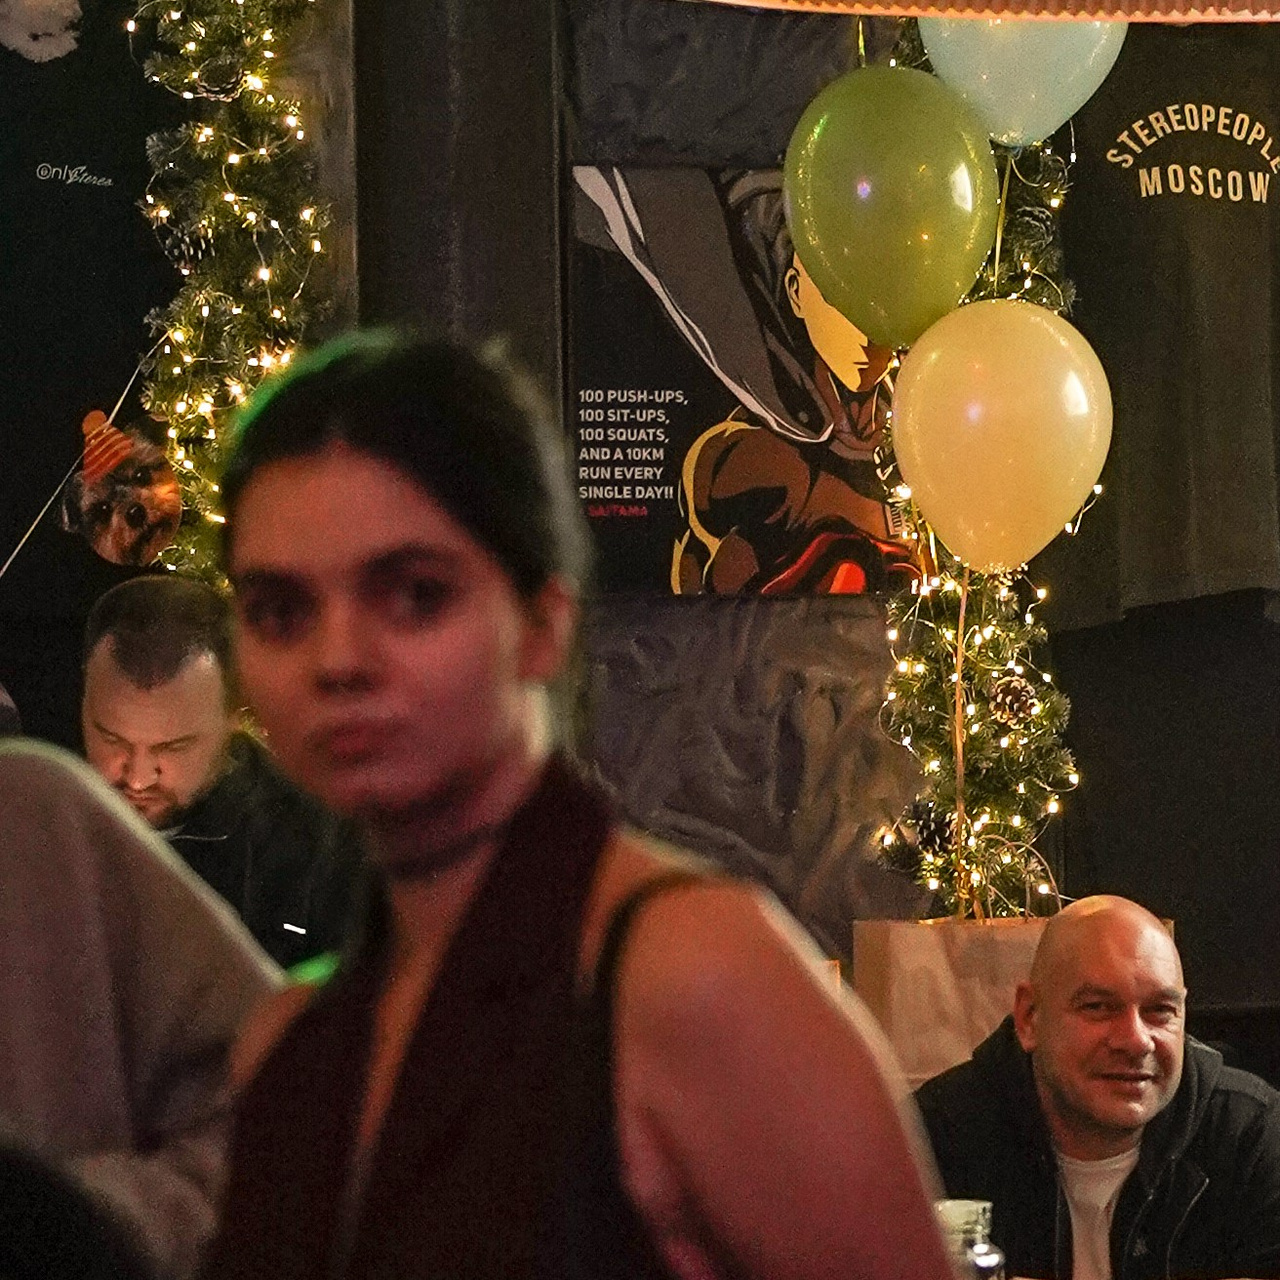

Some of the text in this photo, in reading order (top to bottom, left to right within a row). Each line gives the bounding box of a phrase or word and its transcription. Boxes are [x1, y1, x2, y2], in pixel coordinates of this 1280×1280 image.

[1138, 164, 1271, 204] MOSCOW
[579, 389, 689, 406] 100 PUSH-UPS,
[579, 408, 670, 425] 100 SIT-UPS,
[579, 427, 669, 444] 100 SQUATS,
[579, 447, 665, 461] AND A 10KM
[579, 466, 664, 480] RUN EVERY
[579, 486, 674, 499] SINGLE DAY!!
